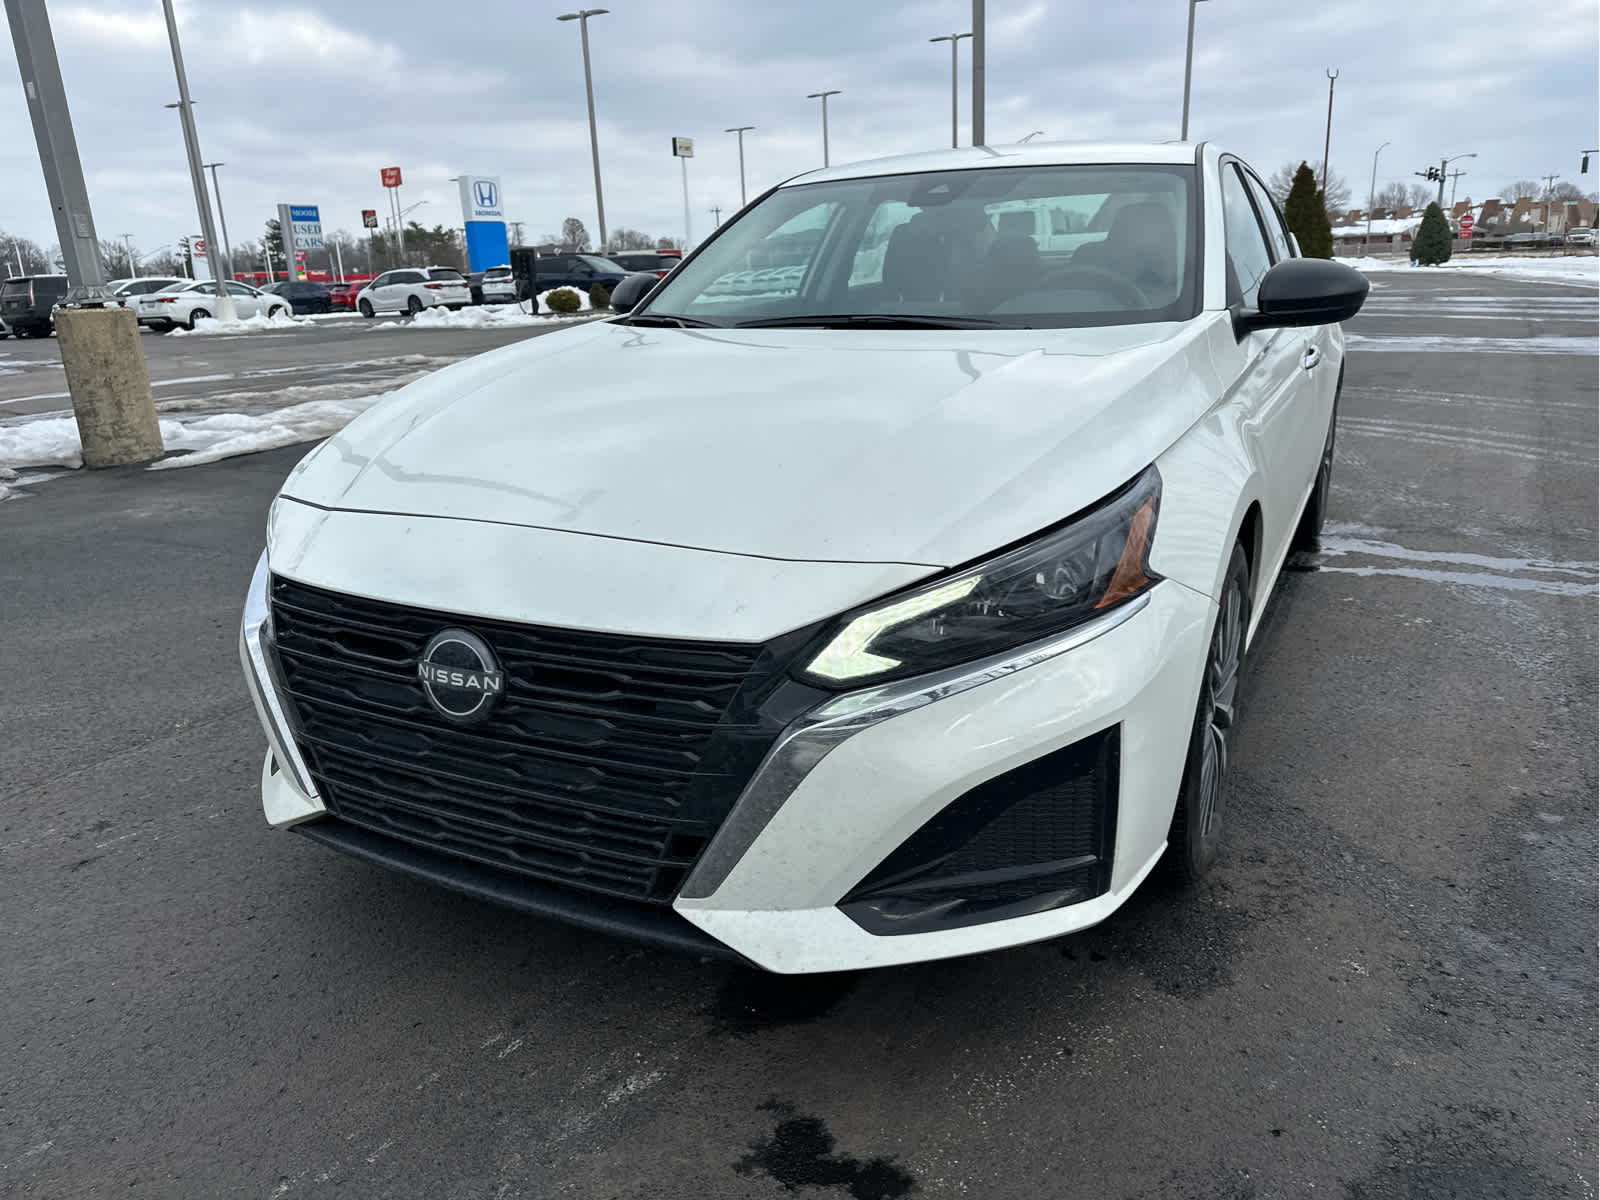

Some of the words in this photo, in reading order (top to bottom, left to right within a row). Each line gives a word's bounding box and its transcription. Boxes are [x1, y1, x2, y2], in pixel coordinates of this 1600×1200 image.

[293, 223, 322, 234] USED
[295, 237, 324, 248] CARS
[418, 663, 499, 690] NISSAN
